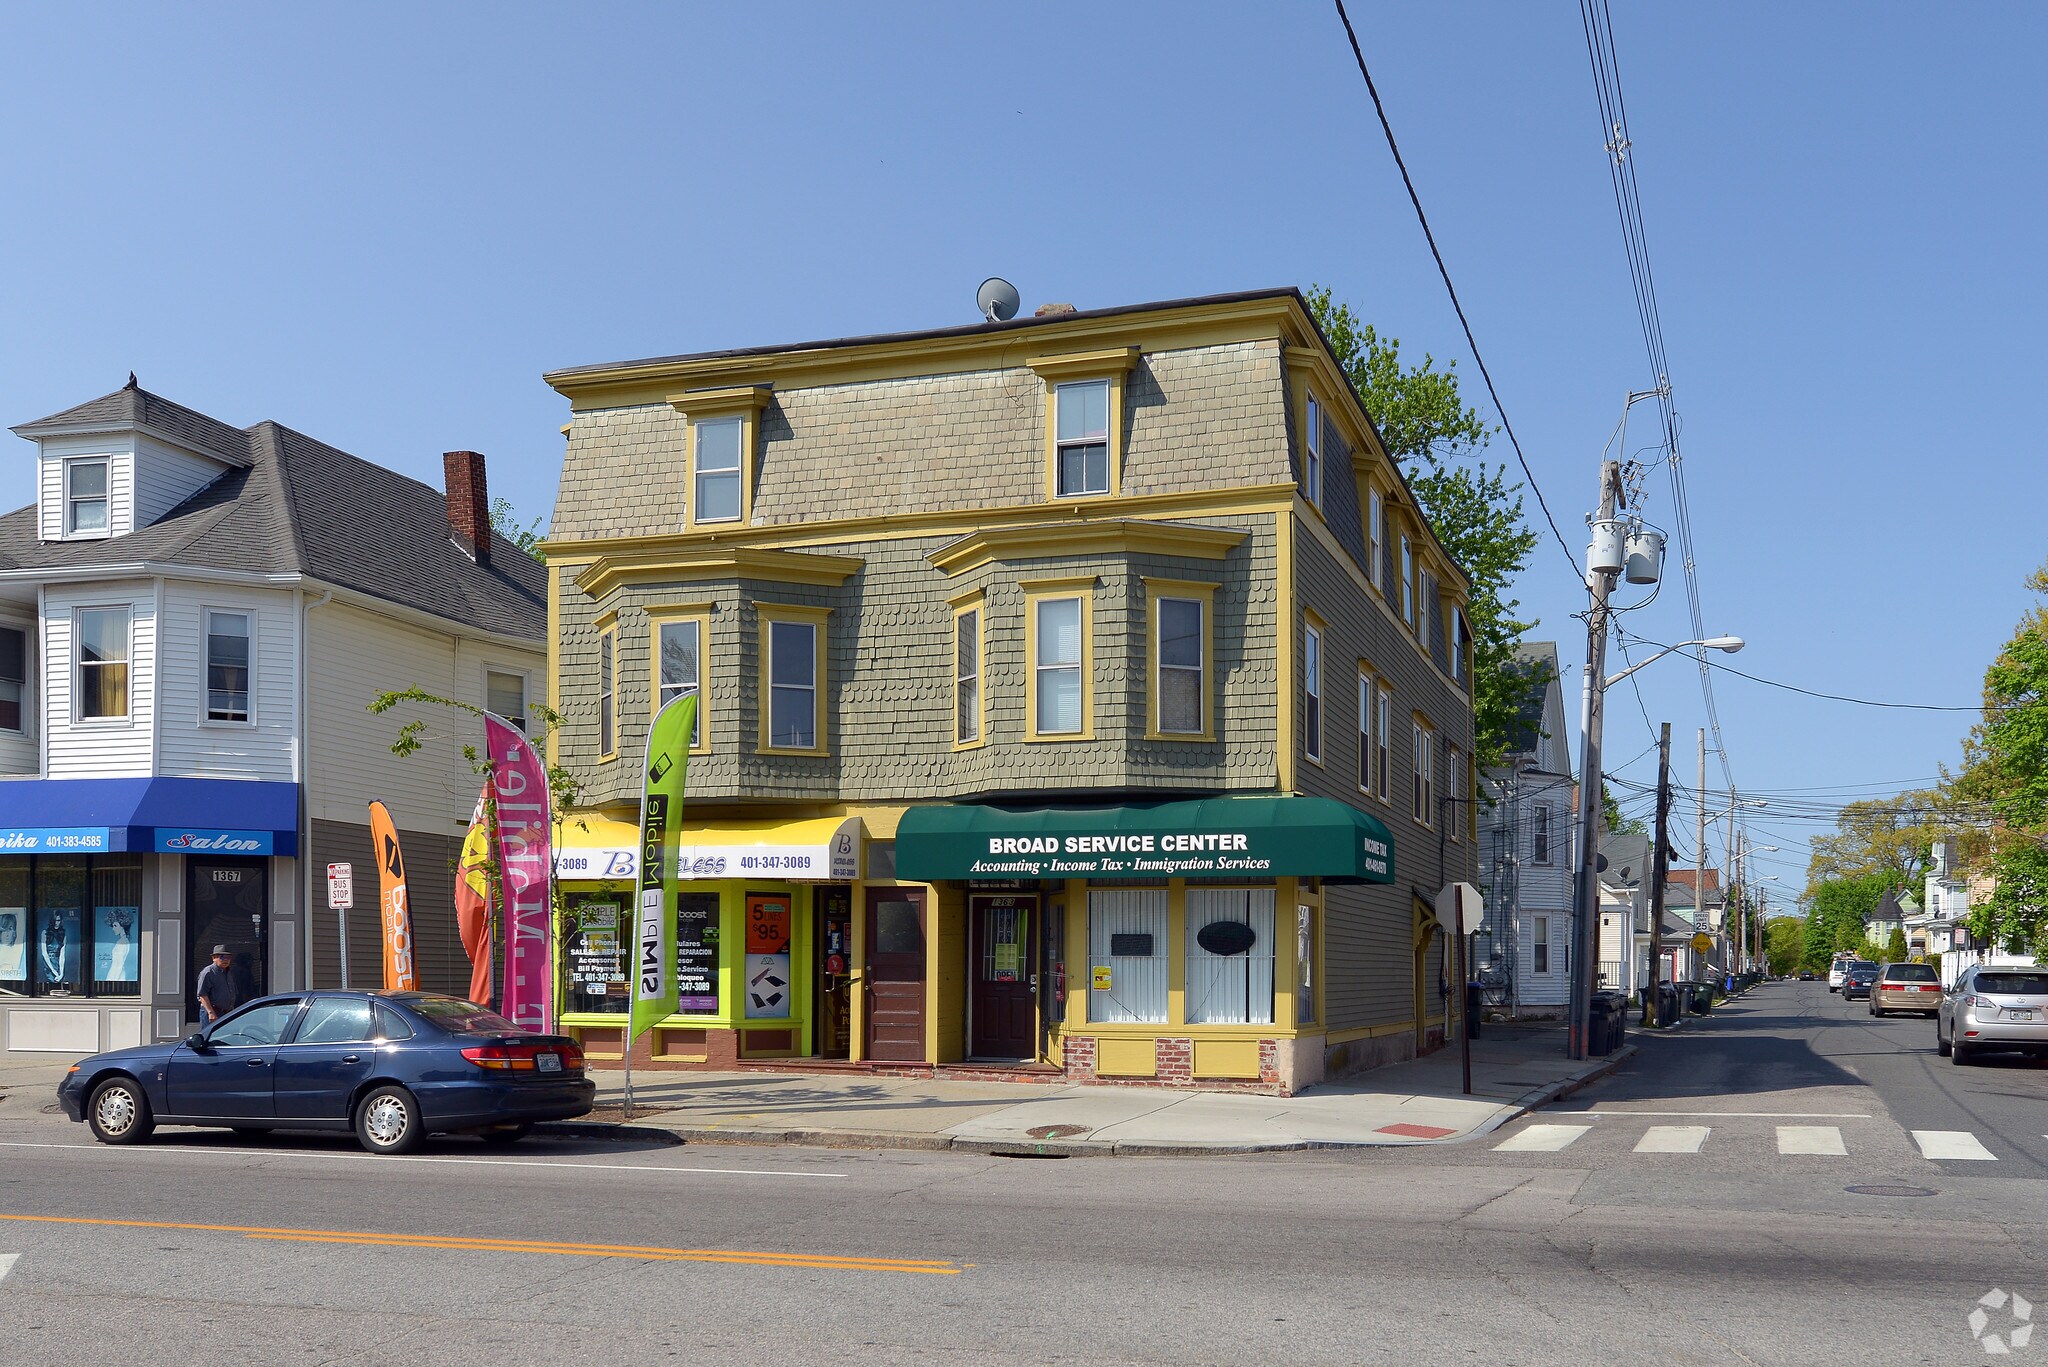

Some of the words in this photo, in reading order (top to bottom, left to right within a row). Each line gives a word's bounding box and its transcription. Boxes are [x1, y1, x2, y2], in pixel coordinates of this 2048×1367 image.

[46, 836, 102, 847] 401-383-4585
[166, 834, 262, 850] Salon
[989, 837, 1059, 854] BROAD
[1065, 835, 1154, 853] SERVICE
[1161, 834, 1248, 852] CENTER
[741, 856, 811, 869] 401-347-3089
[970, 859, 1040, 875] Accounting
[1050, 858, 1097, 872] Income
[1101, 857, 1123, 871] Tax
[1133, 856, 1213, 873] Immigration
[1216, 856, 1270, 870] Services
[214, 871, 241, 882] 1367
[333, 880, 347, 889] BUS
[332, 890, 349, 898] STOP
[384, 890, 394, 943] mobile
[678, 910, 707, 919] boost
[752, 904, 764, 921] 5
[752, 923, 779, 940] $95
[1696, 922, 1708, 930] 25
[392, 884, 412, 988] boost
[601, 948, 627, 956] REPAIR
[678, 948, 713, 956] REPARACION
[585, 972, 625, 982] 401-347-3089
